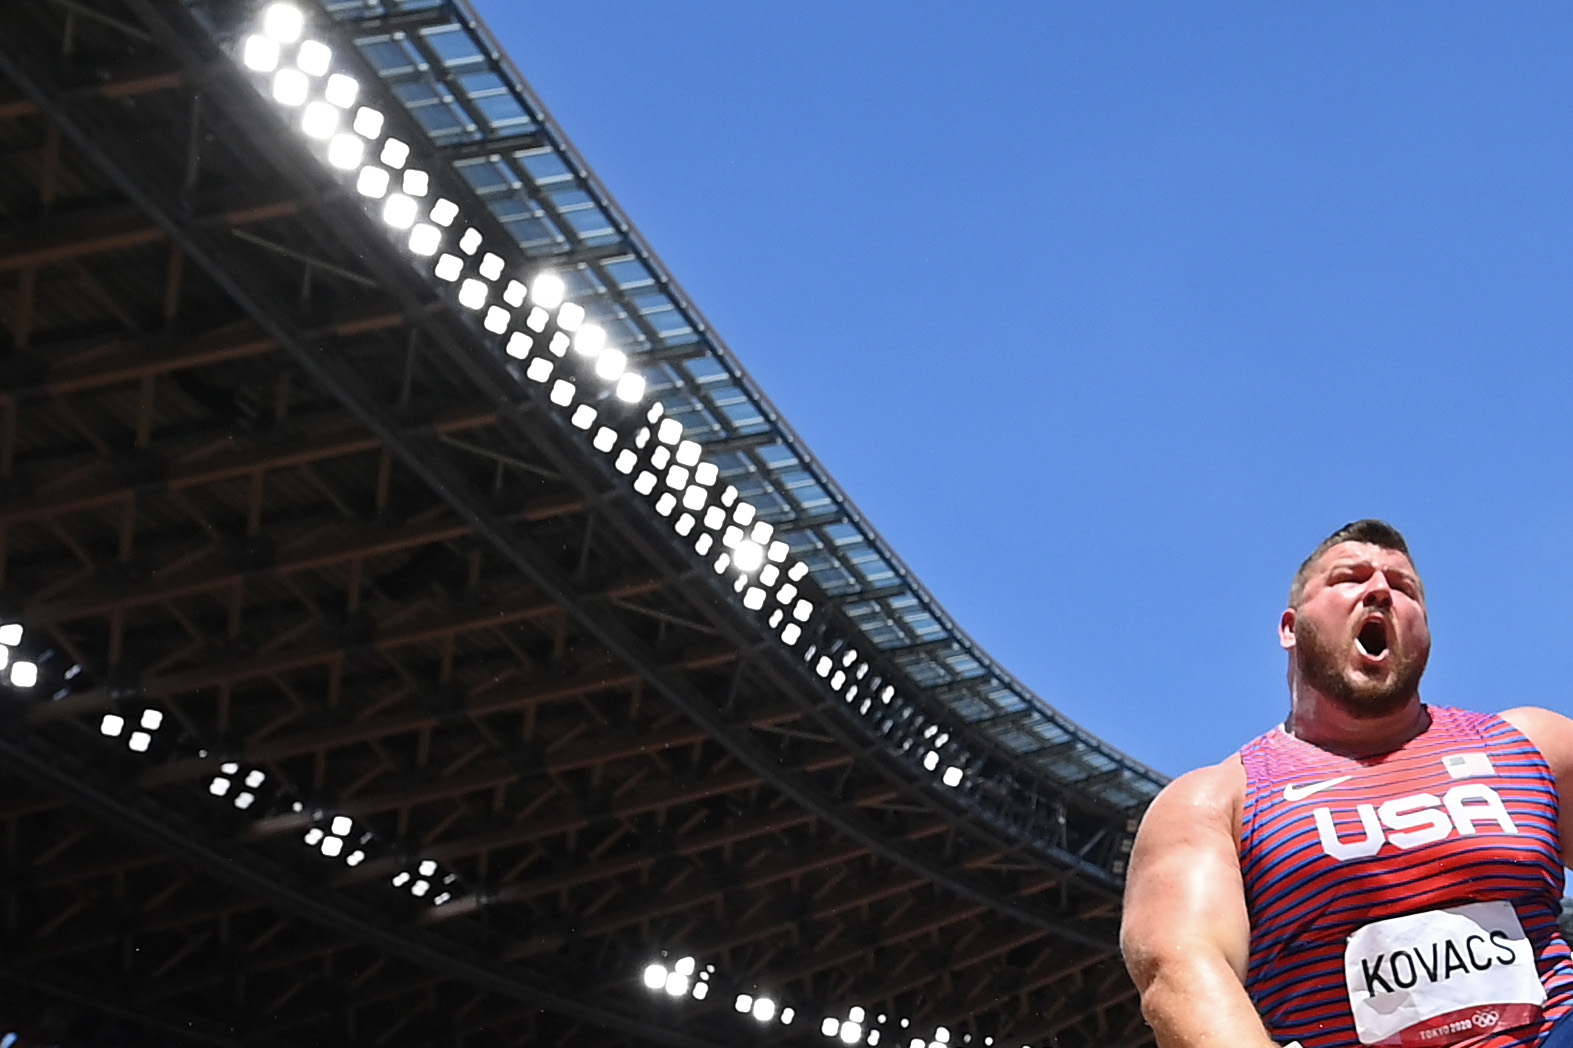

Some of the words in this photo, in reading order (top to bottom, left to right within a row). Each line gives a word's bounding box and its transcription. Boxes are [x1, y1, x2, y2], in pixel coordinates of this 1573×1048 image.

[1313, 783, 1518, 861] USA
[1360, 930, 1516, 998] KOVACS
[1419, 1025, 1450, 1040] TOKYO
[1450, 1019, 1473, 1034] 2020
